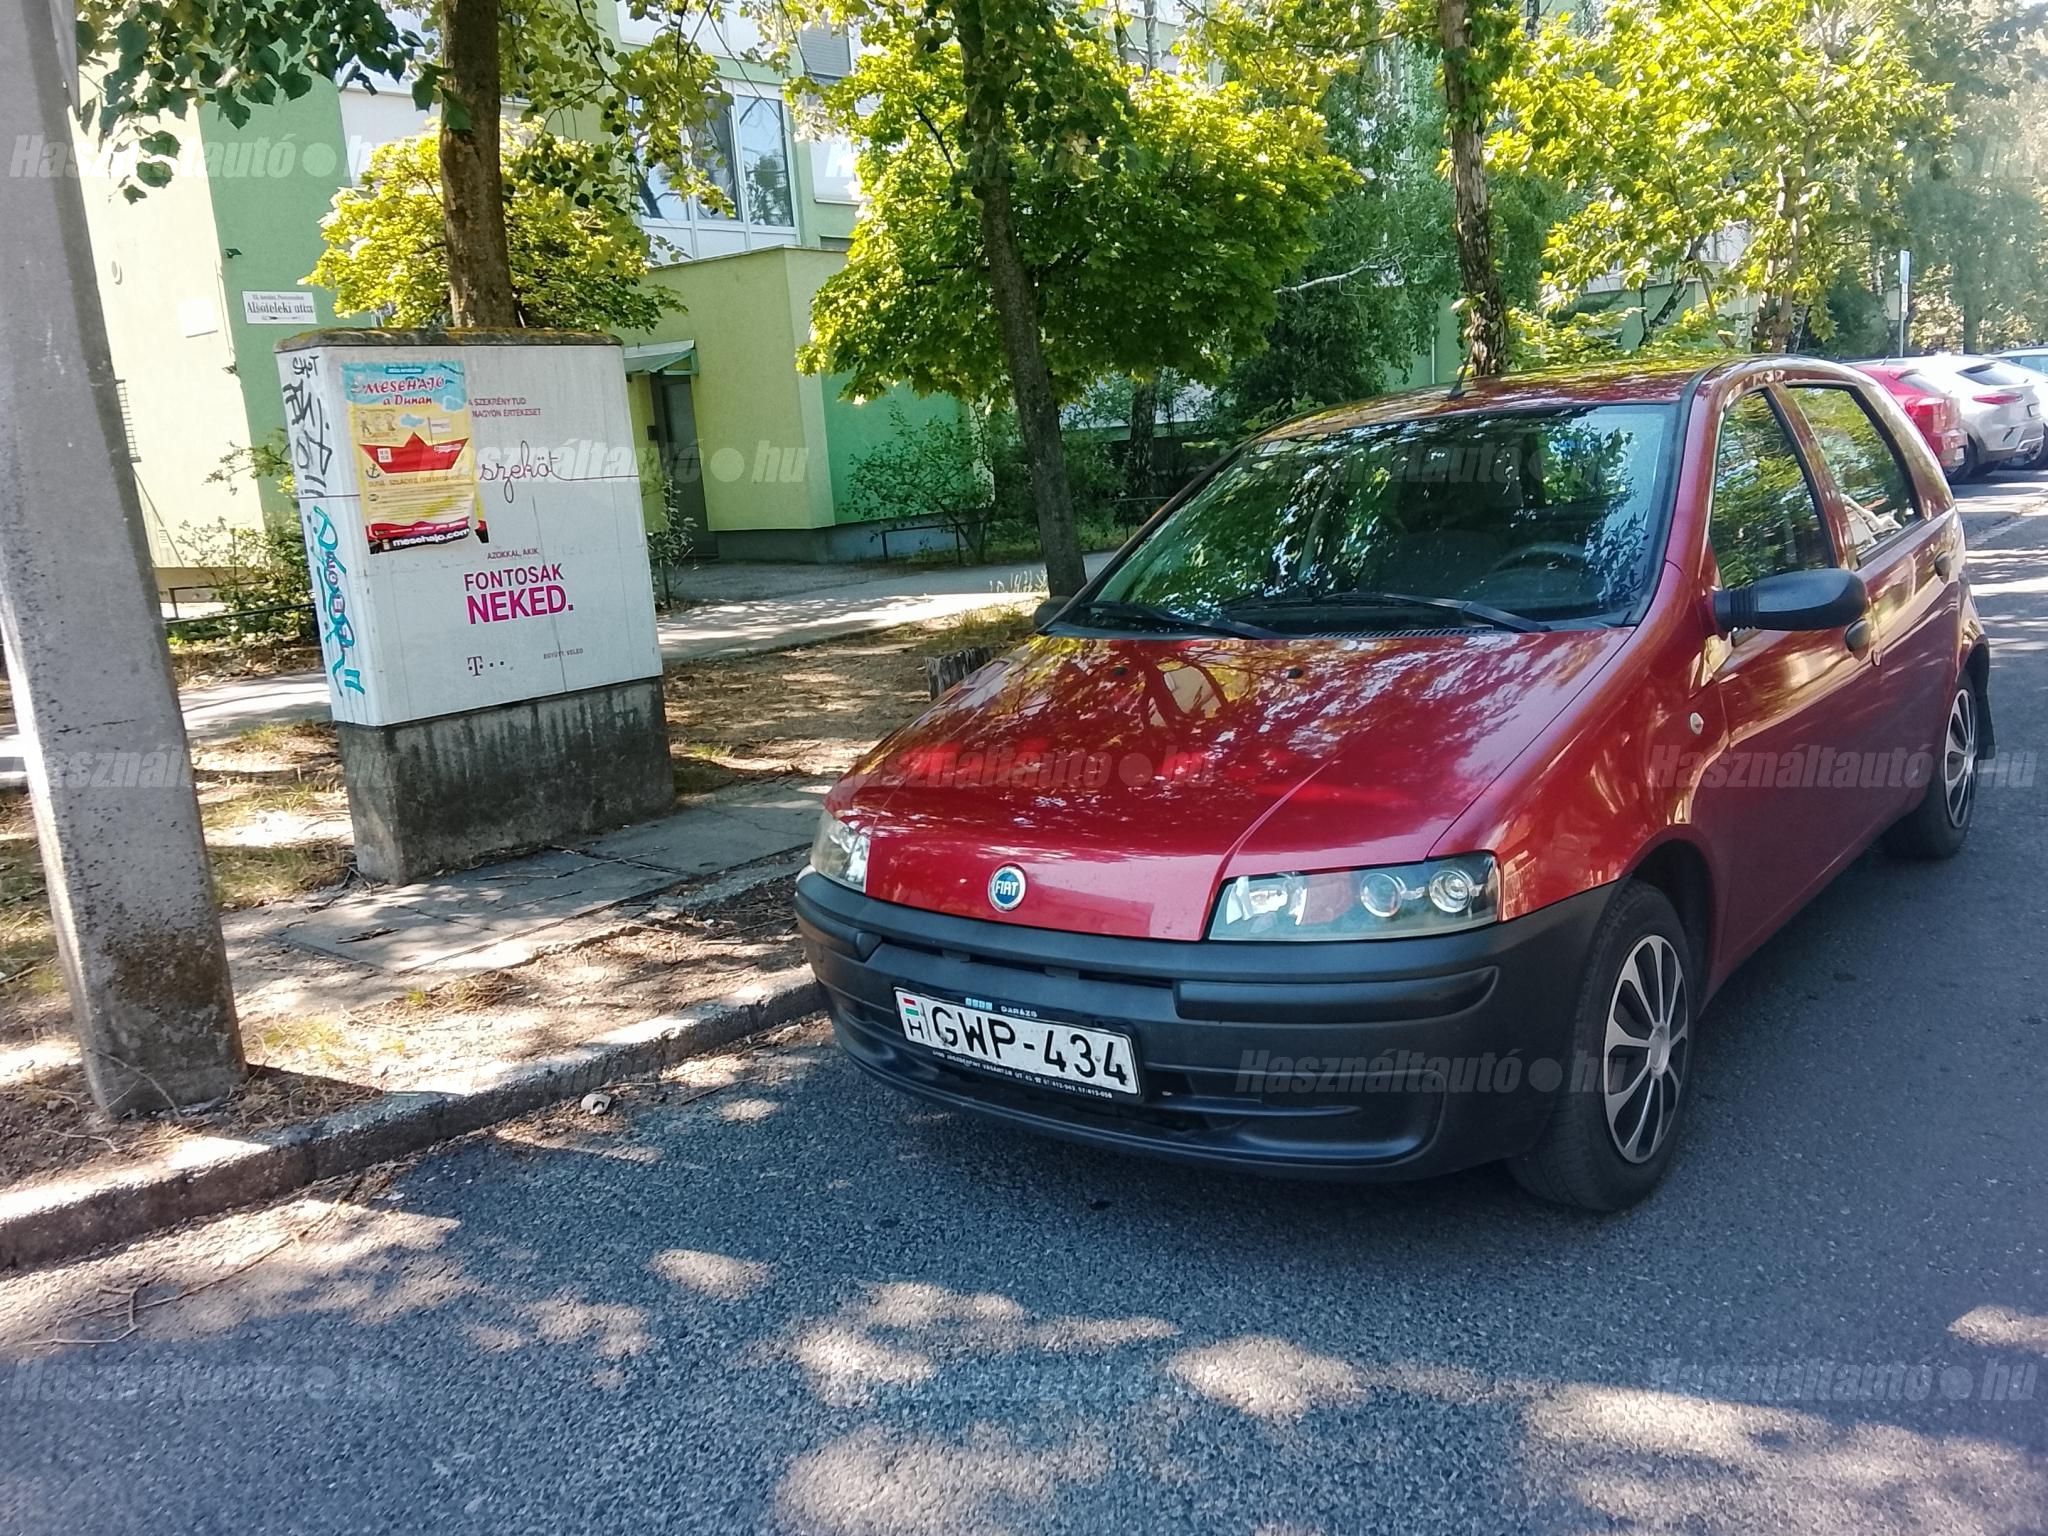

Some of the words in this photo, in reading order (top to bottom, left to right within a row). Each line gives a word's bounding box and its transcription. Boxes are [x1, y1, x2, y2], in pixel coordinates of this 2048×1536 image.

[294, 303, 314, 313] utca
[479, 440, 560, 504] szeköt
[464, 563, 565, 592] FONTOSAK
[466, 585, 574, 625] NEKED.
[995, 880, 1018, 896] FIAT
[907, 1018, 924, 1040] H
[931, 1006, 1126, 1085] GWP-434
